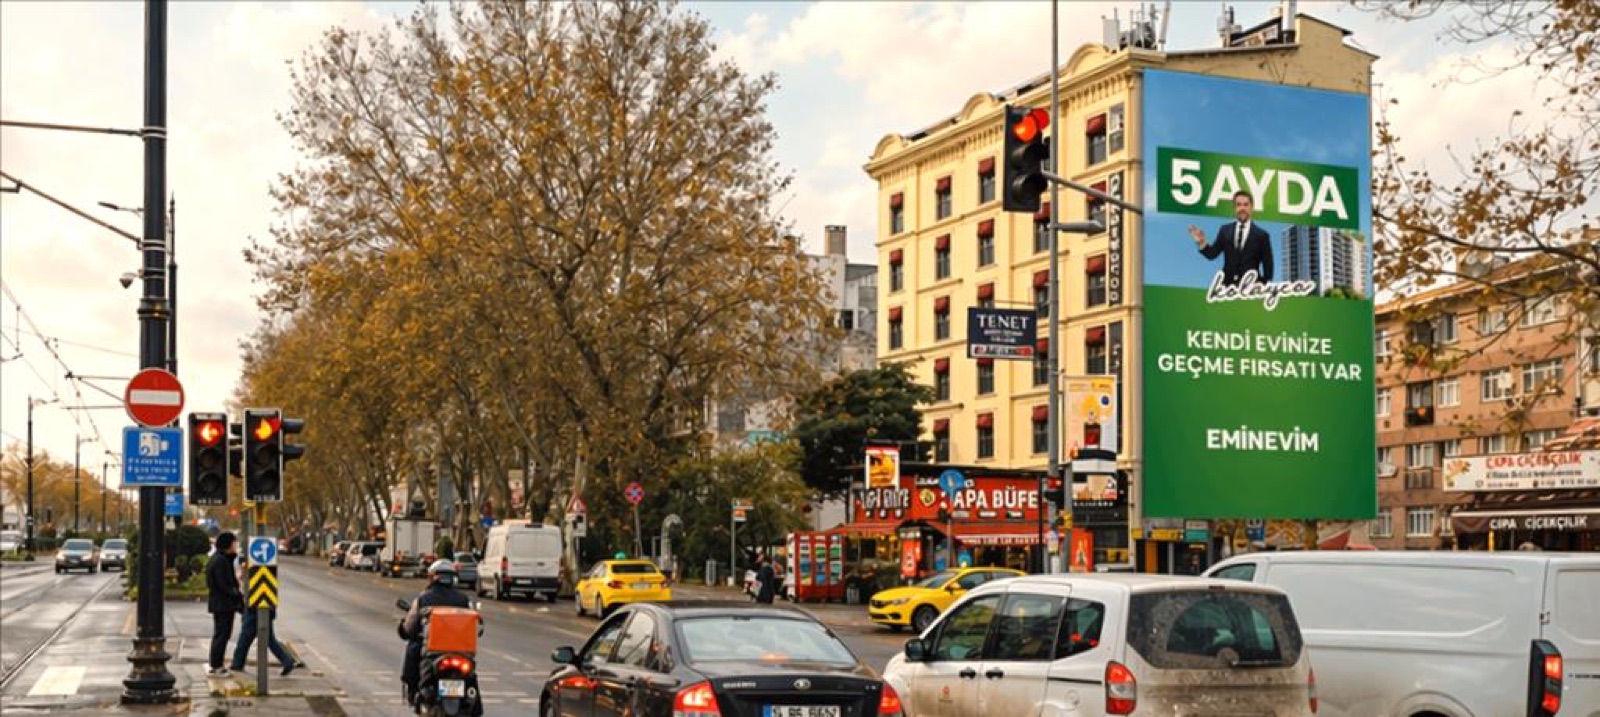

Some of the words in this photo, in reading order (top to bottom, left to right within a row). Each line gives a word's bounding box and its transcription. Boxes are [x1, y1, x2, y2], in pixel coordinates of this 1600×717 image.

[1171, 158, 1202, 205] 5
[1206, 164, 1349, 220] AYDA
[1209, 271, 1314, 308] kolayca
[976, 314, 1030, 329] TENET
[1187, 329, 1250, 350] KENDİ
[1255, 331, 1332, 355] EVİNİZE
[1158, 354, 1234, 379] GEÇME
[1240, 358, 1316, 379] FIRSATI
[1320, 363, 1361, 381] VAR
[1206, 425, 1319, 452] EMİNEVİM
[992, 485, 1038, 509] BÜFE
